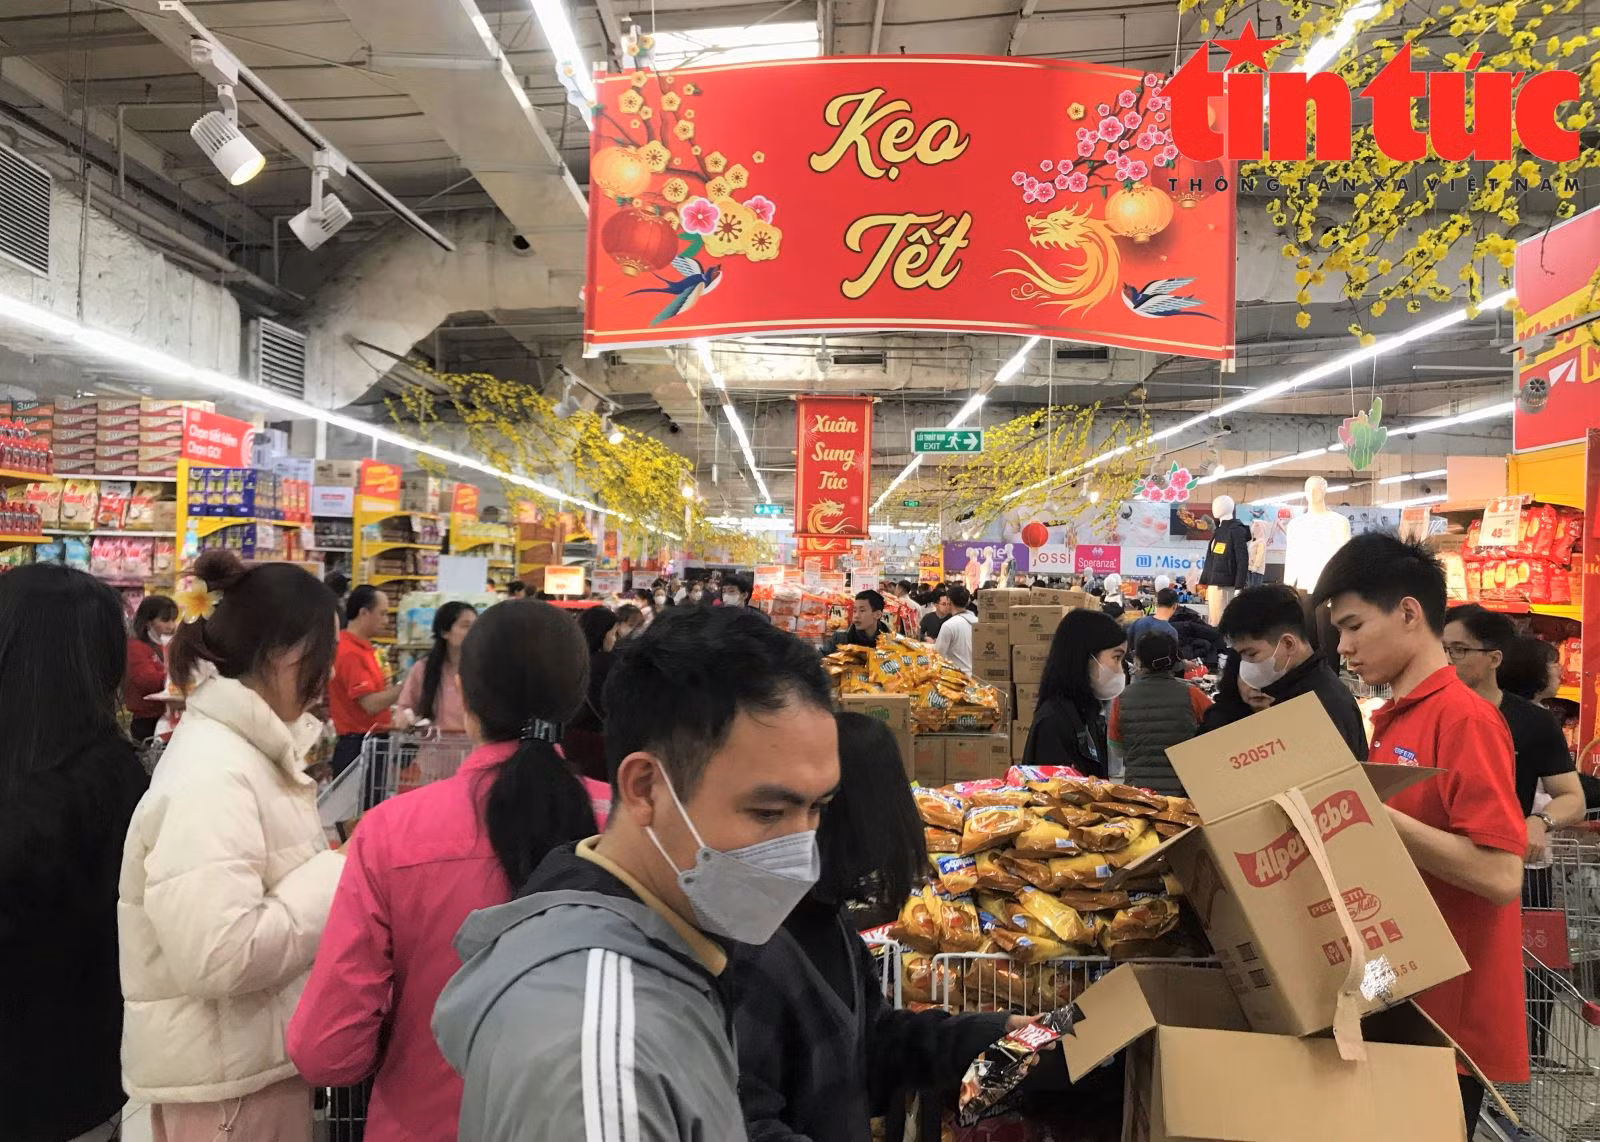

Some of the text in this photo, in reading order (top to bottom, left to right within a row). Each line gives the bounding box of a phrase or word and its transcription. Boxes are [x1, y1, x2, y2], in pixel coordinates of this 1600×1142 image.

[809, 88, 969, 181] Kẹo
[841, 211, 971, 299] Tết
[811, 415, 859, 433] Xuân
[811, 441, 856, 471] Sung
[923, 442, 941, 450] EXIT
[818, 471, 848, 490] Túc
[1078, 557, 1116, 569] Speranza
[1229, 738, 1287, 770] 320571
[1256, 799, 1353, 883] Alpenebe
[1311, 889, 1364, 914] PERETTI
